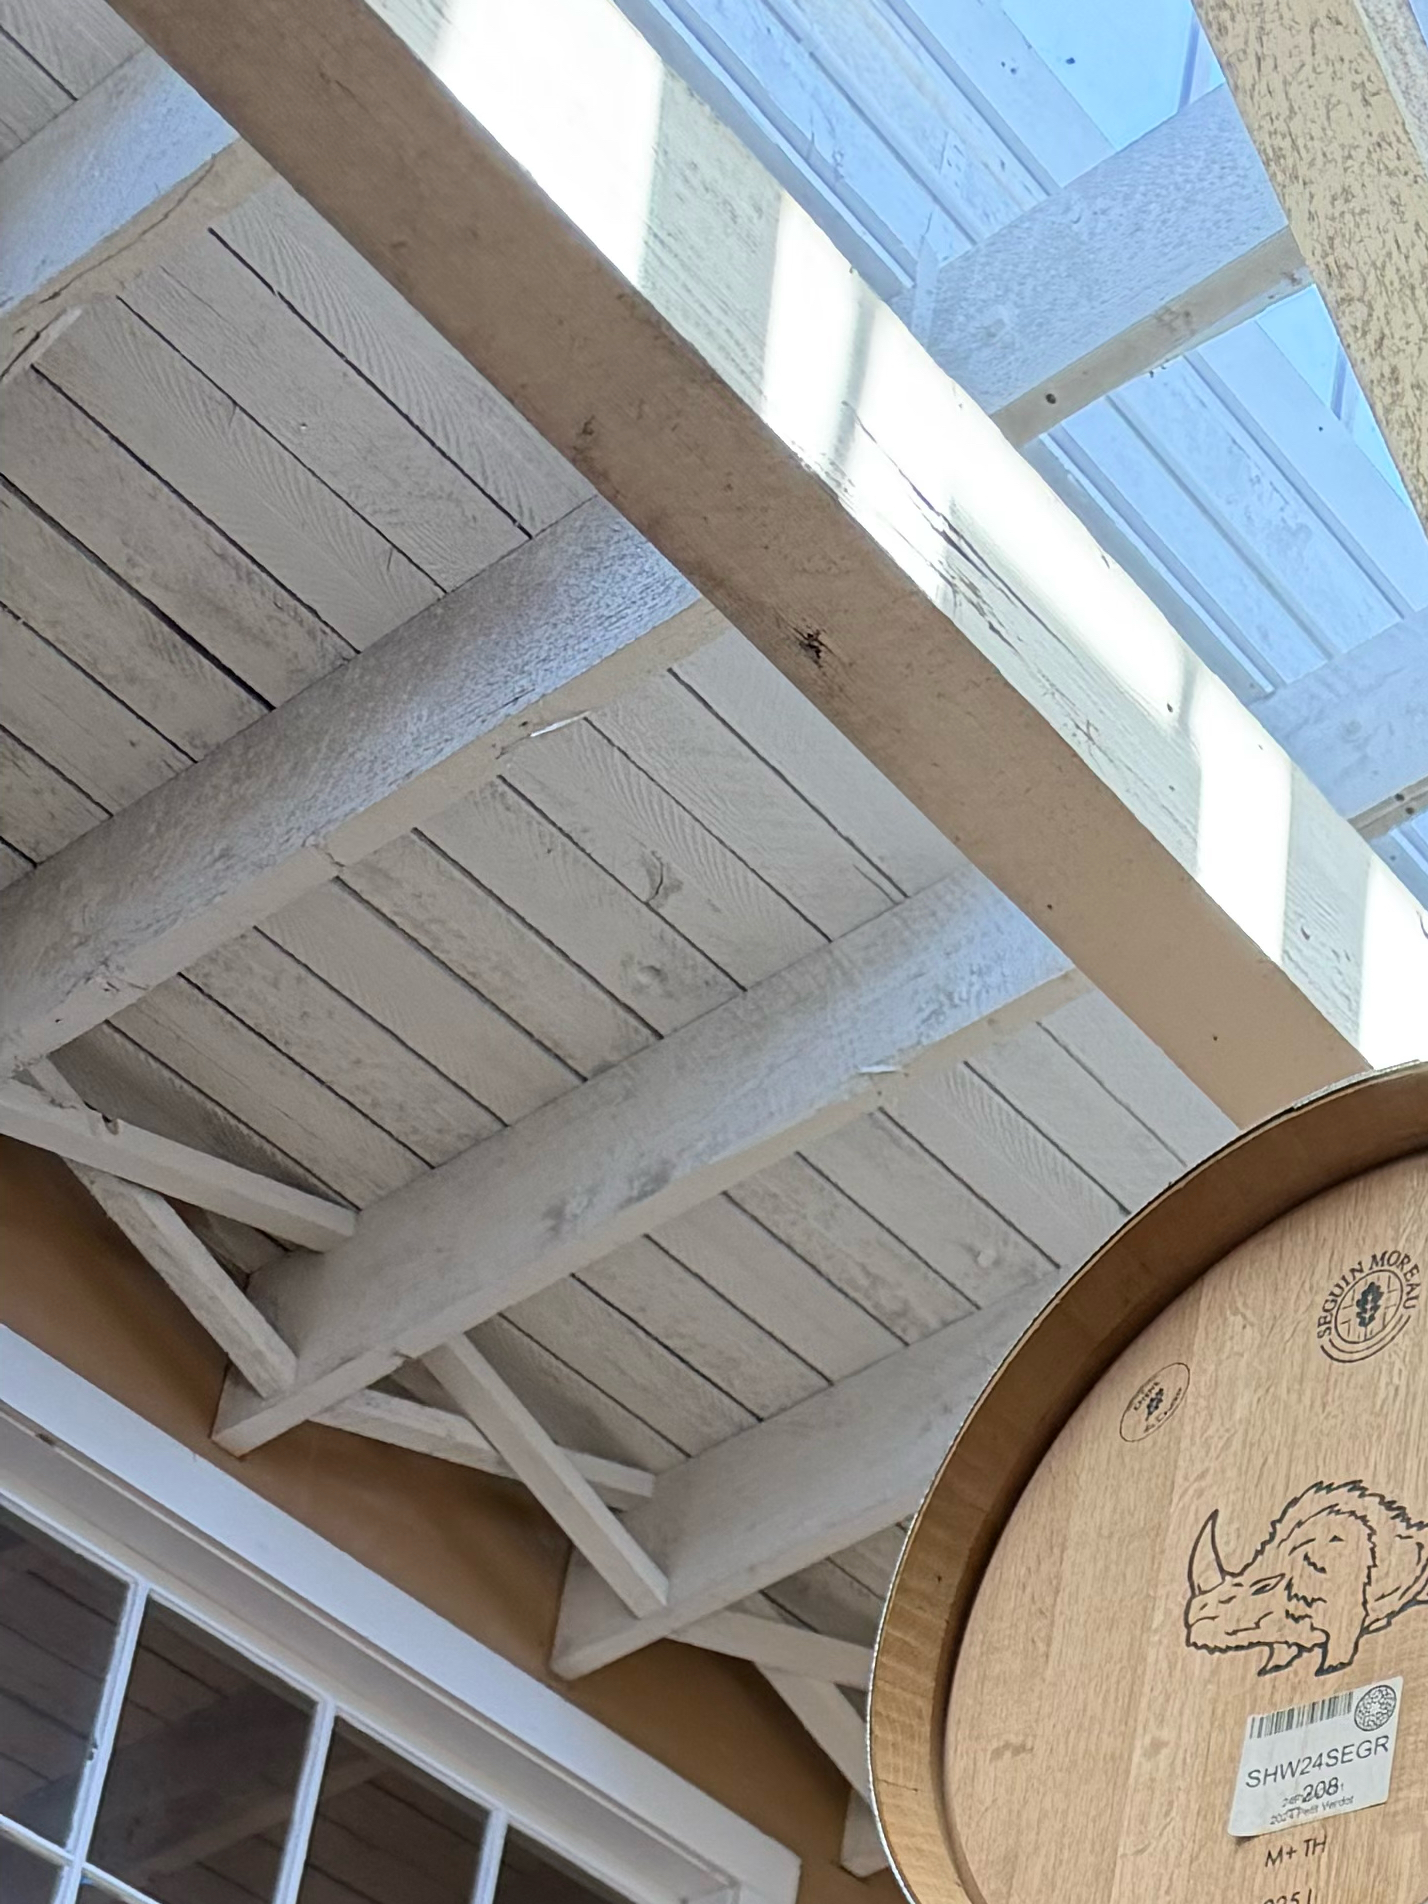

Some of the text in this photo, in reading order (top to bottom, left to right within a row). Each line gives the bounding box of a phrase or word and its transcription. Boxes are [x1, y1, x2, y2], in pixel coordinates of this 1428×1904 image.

[1316, 1249, 1422, 1340] SEGUIN MOREAU
[1245, 1734, 1390, 1789] SHW24SEGR
[1303, 1833, 1328, 1858] TH
